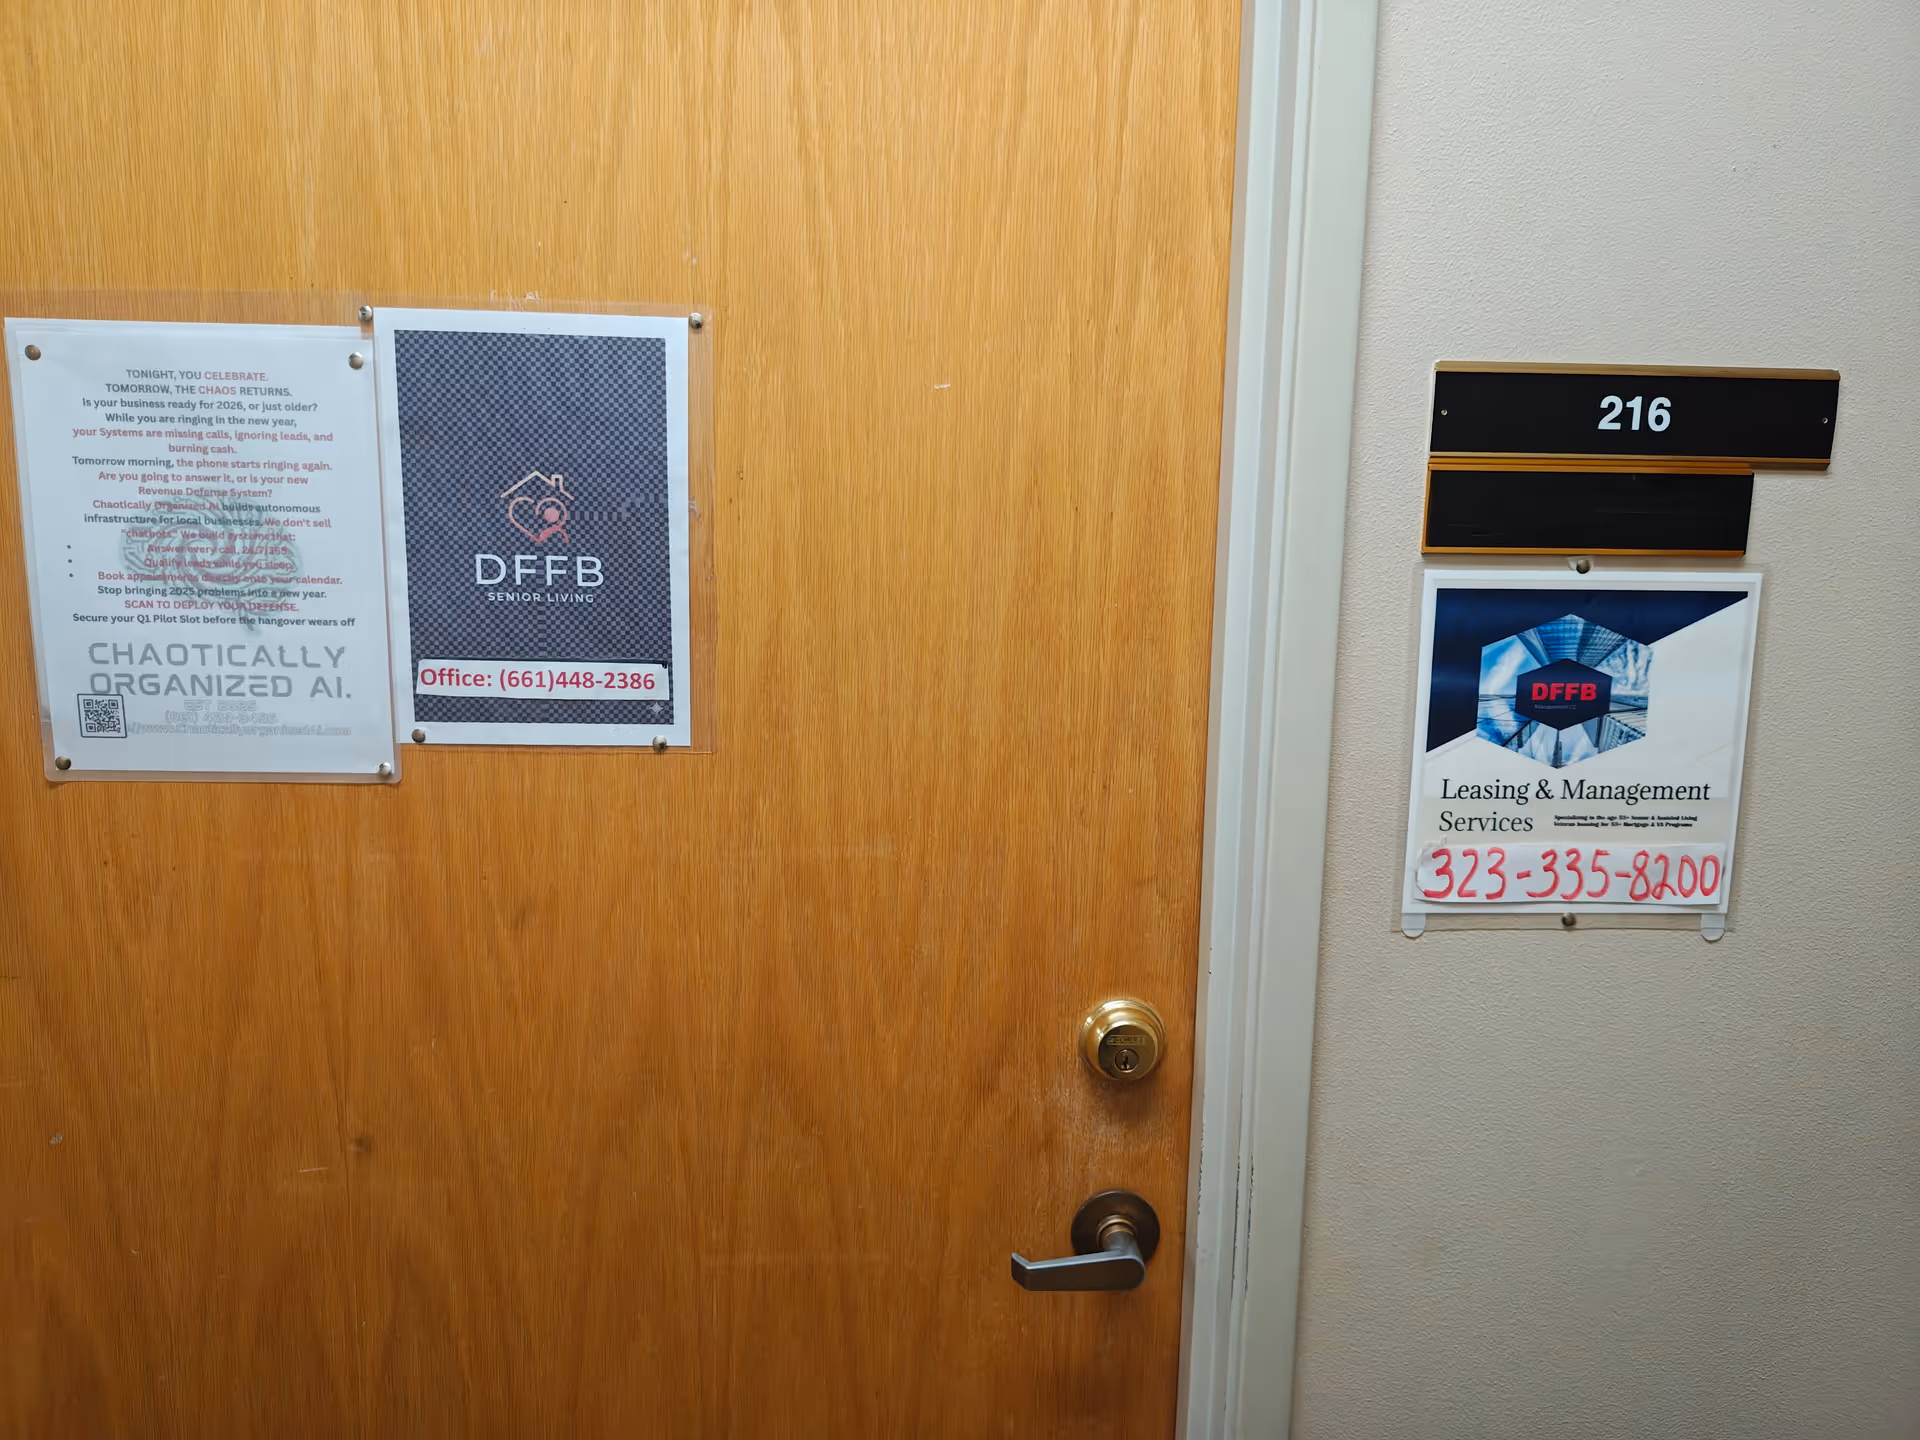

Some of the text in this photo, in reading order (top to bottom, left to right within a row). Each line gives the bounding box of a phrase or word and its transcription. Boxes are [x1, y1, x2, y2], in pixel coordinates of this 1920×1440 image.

[126, 369, 269, 382] TONIGHT, YOU CELEBRATE.
[105, 383, 293, 397] TOMORROW, THE CHAOS RETURNS.
[82, 397, 91, 407] Is
[94, 400, 118, 409] your
[120, 398, 165, 408] business
[167, 400, 197, 411] ready
[199, 400, 214, 409] for
[216, 401, 246, 412] 2026,
[262, 402, 282, 412] just
[284, 402, 318, 412] older?
[105, 413, 135, 422] While
[137, 415, 156, 425] you
[178, 415, 213, 426] ringing
[216, 416, 225, 425] in
[227, 416, 245, 425] the
[271, 418, 297, 428] year,
[1597, 395, 1672, 432] 216
[72, 428, 333, 443] your Systems are missing calls, ignoring leads, and
[168, 443, 237, 455] burning cash.
[72, 456, 333, 472] Tomorrow morning, the phone starts ringing again.
[99, 471, 308, 485] Are you going to answer it, or is your new
[138, 486, 272, 499] Revenue Defense System?
[92, 500, 152, 511] Chaotically
[154, 501, 206, 512] Organized
[222, 502, 253, 511] builds
[256, 504, 321, 513] autonomous
[84, 513, 332, 528] infrastructure for local businesses. We don't sell
[180, 530, 198, 539] We
[199, 530, 225, 540] build
[147, 544, 184, 553] Answer
[187, 546, 215, 556] every
[144, 558, 180, 570] Qualify
[184, 558, 211, 568] leads
[474, 553, 605, 587] DFFB
[98, 571, 124, 580] Book
[127, 572, 200, 584] appointments
[270, 576, 293, 586] your
[296, 575, 343, 585] calendar.
[97, 586, 122, 596] Stop
[124, 586, 167, 597] bringing
[169, 587, 195, 596] 2025
[197, 587, 246, 598] problems
[248, 588, 268, 597] into
[302, 591, 328, 601] year.
[487, 592, 595, 603] SENIOR LIVING
[124, 600, 299, 612] SCAN TO DEPLOY YOUR DEFENSE.
[72, 613, 356, 627] Secure your Q1 Pilot Slot before the hangover wears off
[88, 642, 346, 669] CHAOTICALLY
[90, 672, 352, 699] ORGANIZED AI.
[420, 667, 656, 692] Office: (661)448-2386
[1532, 682, 1597, 701] DFFB
[1440, 778, 1711, 806] Leasing & Management
[1438, 810, 1534, 833] Services
[1423, 847, 1721, 902] 323-335-8200
